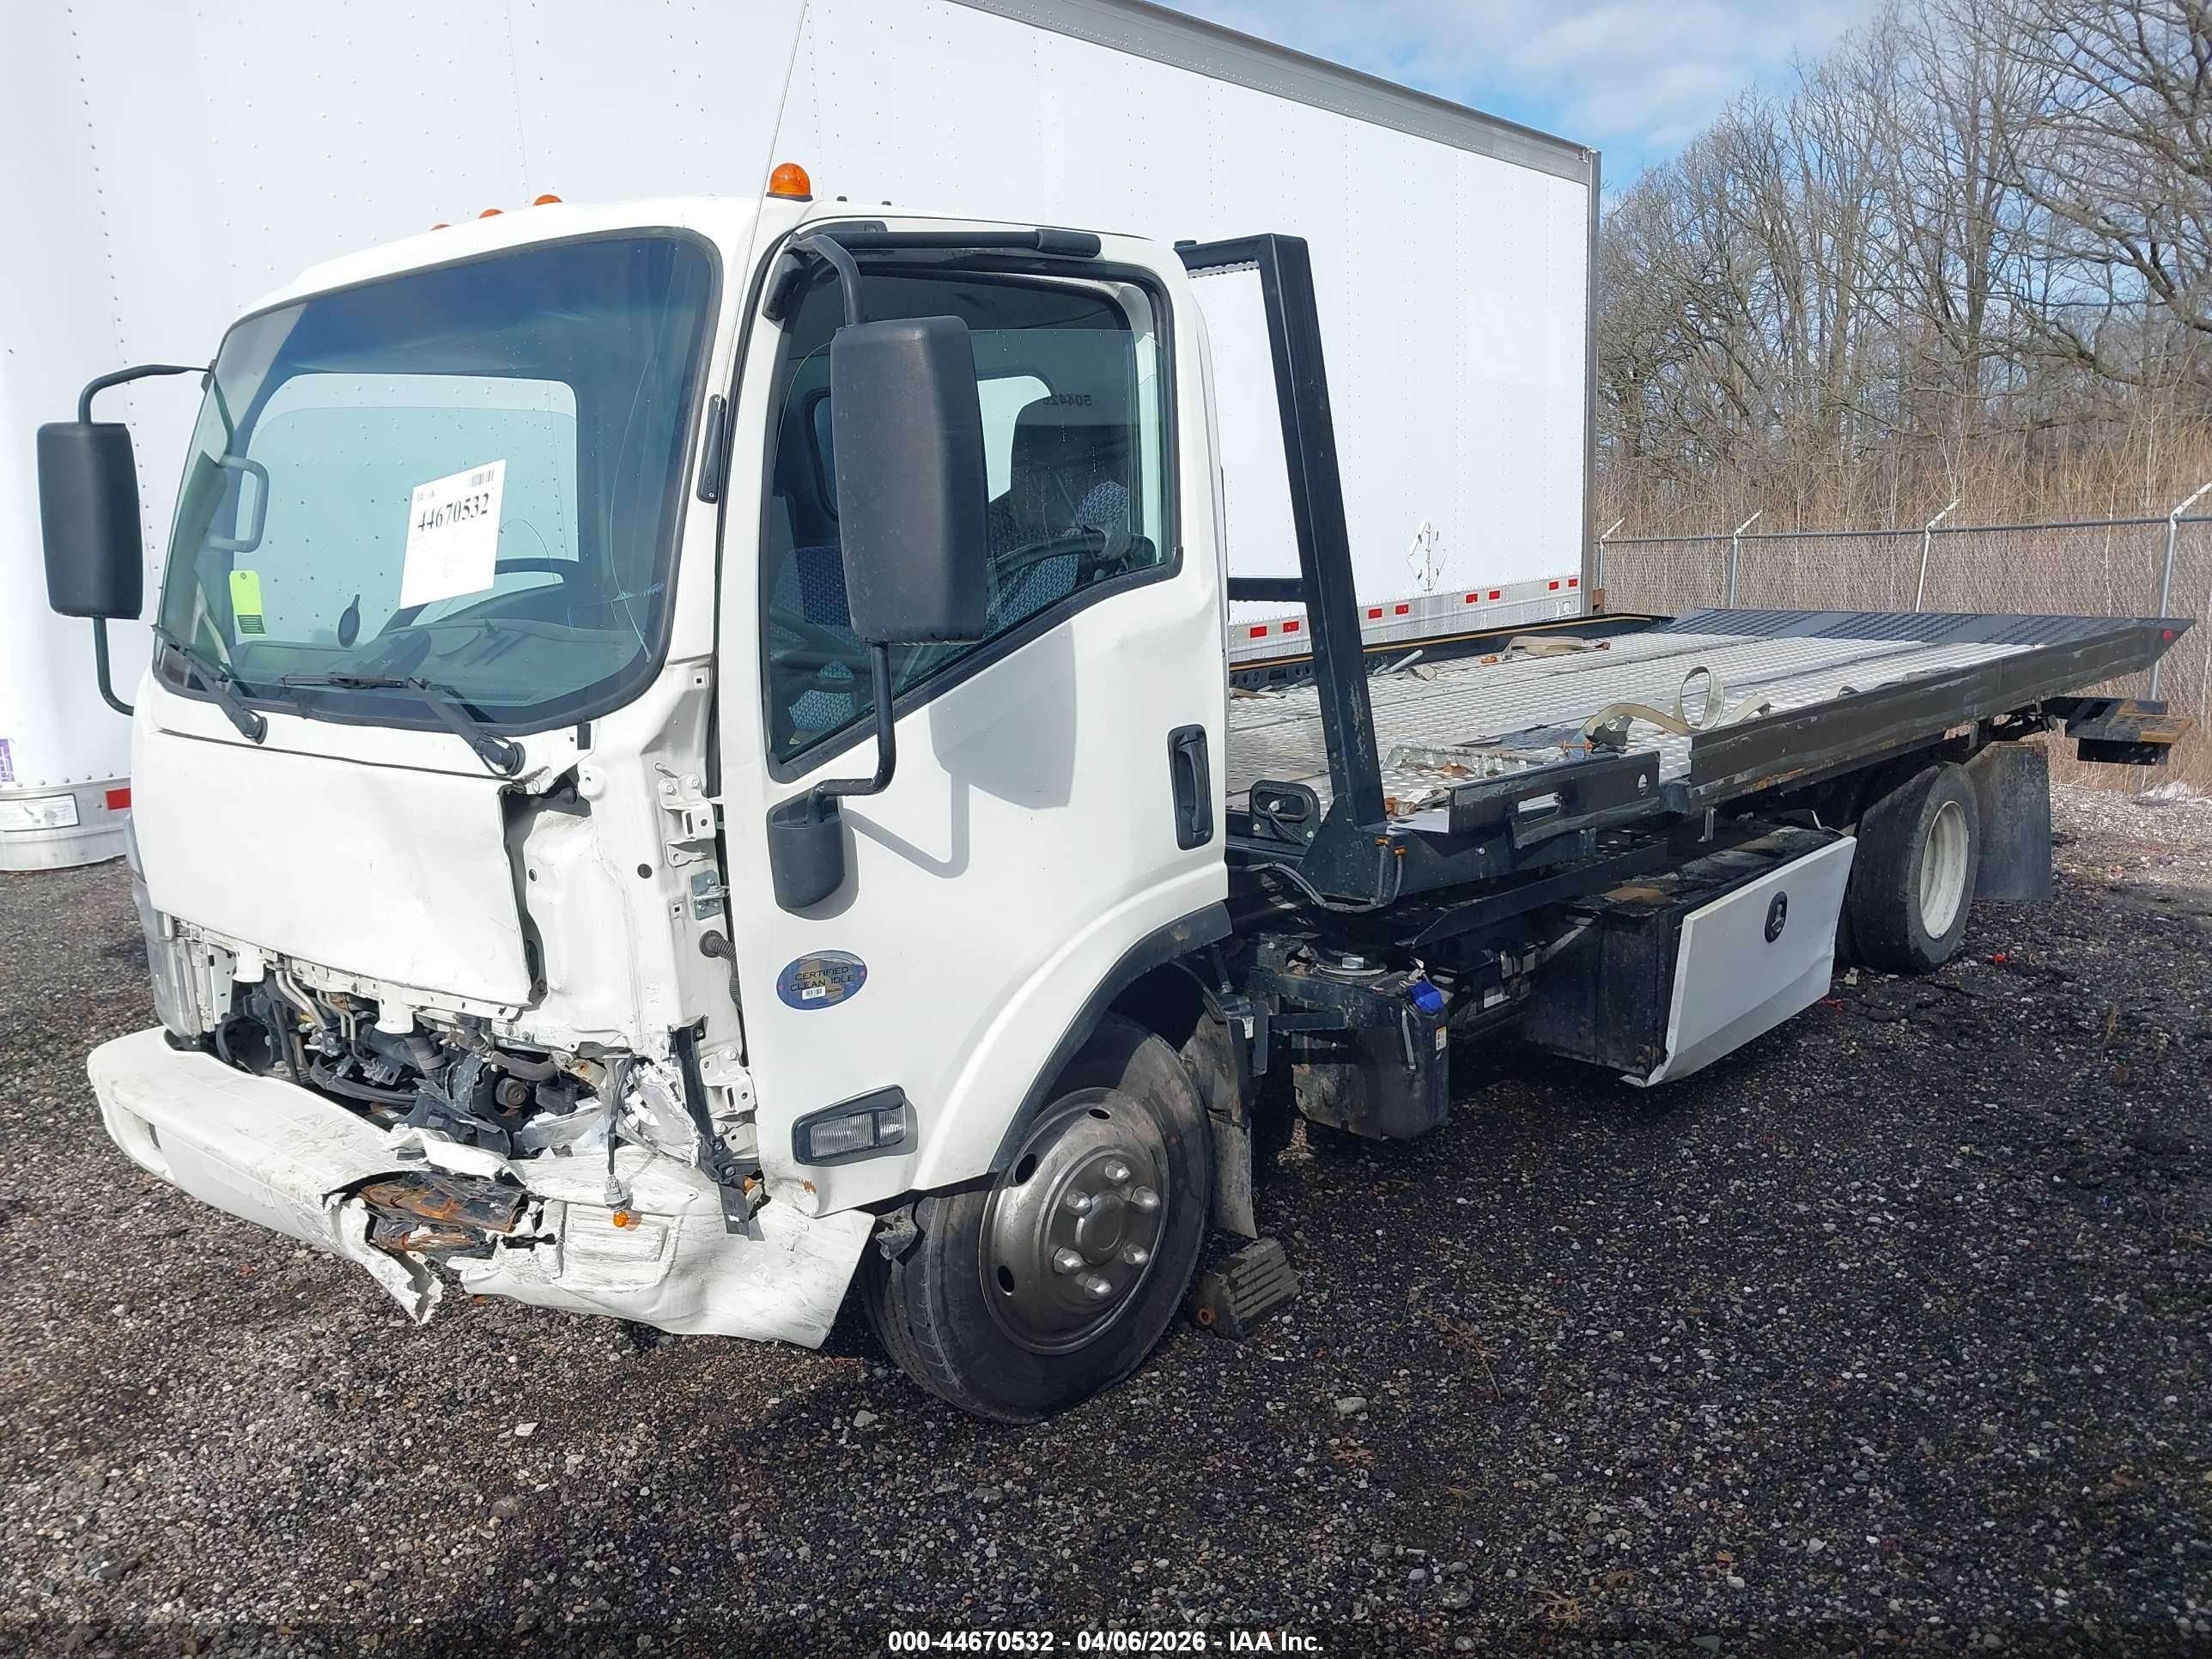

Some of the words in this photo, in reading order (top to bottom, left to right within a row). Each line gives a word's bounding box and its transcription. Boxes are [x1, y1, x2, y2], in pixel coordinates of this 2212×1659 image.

[417, 493, 489, 532] 44670532
[794, 966, 849, 981] CERTIFIED
[790, 979, 826, 991] CLEAN
[830, 975, 854, 985] IDLE
